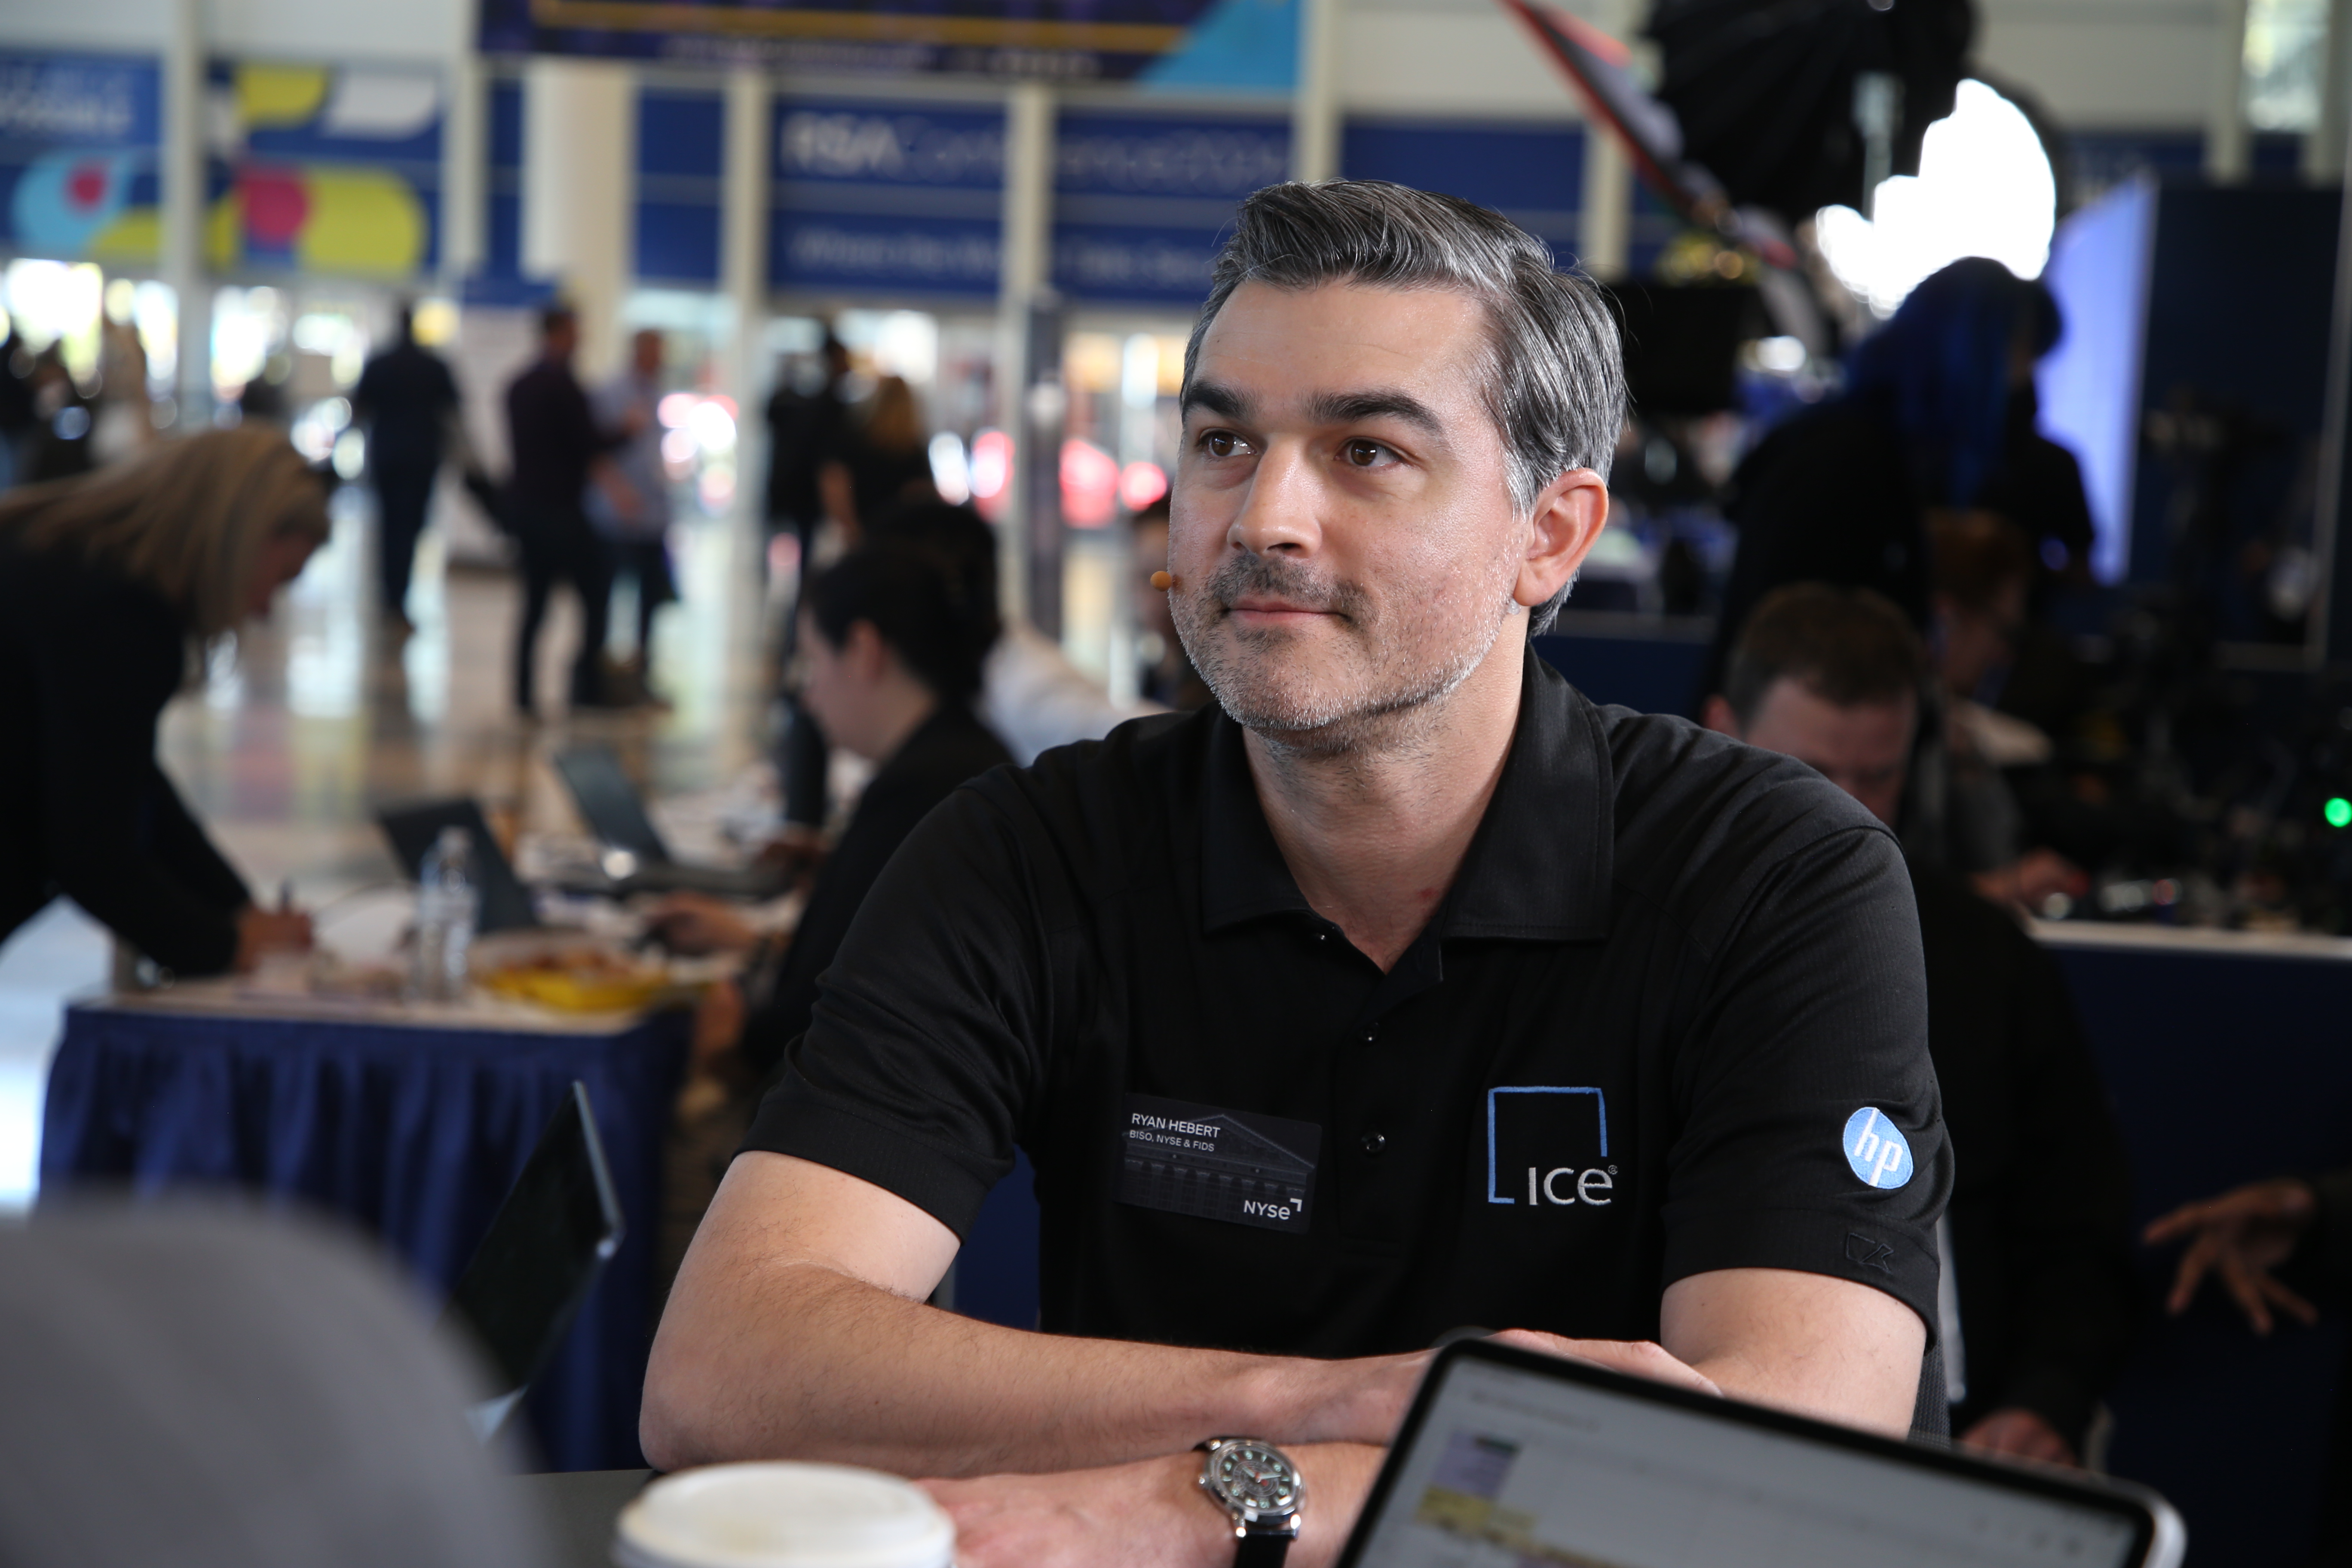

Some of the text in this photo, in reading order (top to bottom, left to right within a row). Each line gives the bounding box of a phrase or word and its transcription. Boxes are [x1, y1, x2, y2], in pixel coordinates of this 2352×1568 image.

[1131, 1113, 1221, 1138] RYAN HEBERT
[1129, 1130, 1215, 1152] BISO, NYSE & FIDS
[1854, 1107, 1904, 1187] hp
